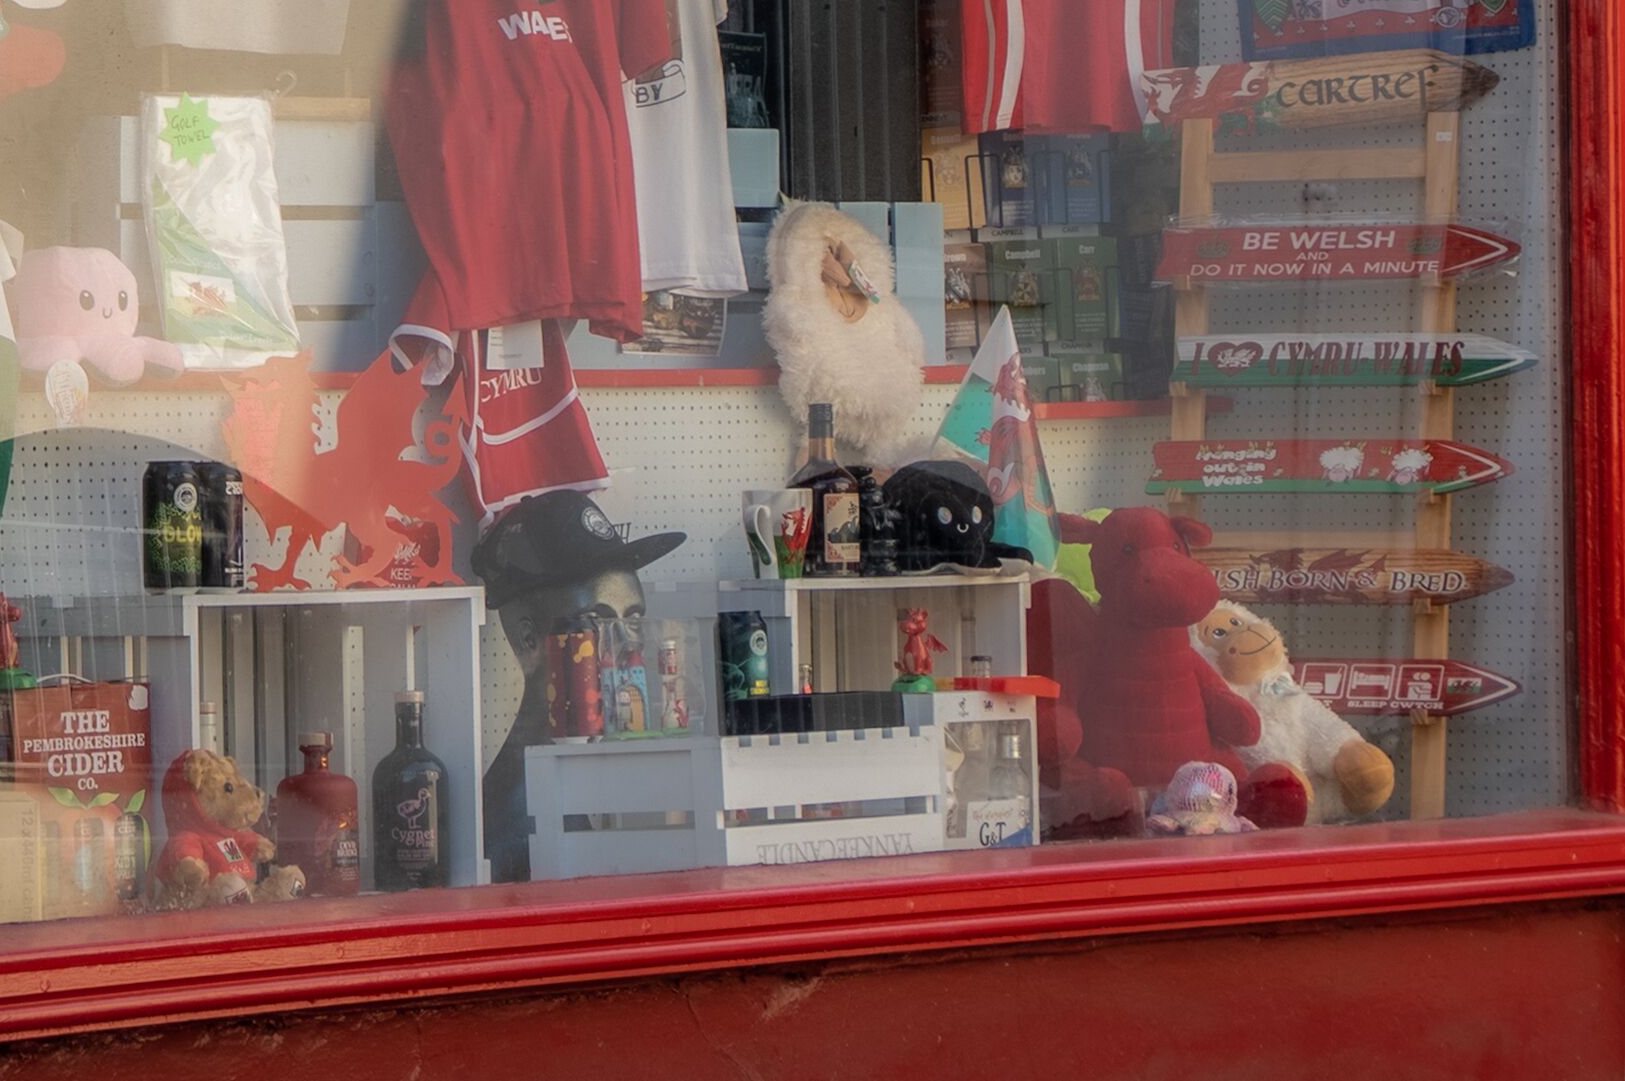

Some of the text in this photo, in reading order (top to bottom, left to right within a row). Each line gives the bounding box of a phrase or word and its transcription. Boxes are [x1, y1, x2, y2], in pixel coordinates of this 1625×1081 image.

[635, 83, 664, 104] BY
[171, 114, 200, 132] GOLF
[173, 128, 211, 148] TOWEL
[1242, 230, 1396, 251] BE WELSH
[1296, 251, 1329, 262] AND
[1189, 260, 1440, 277] DO IT NOW IN A MINUTE
[1191, 341, 1205, 377] I
[480, 366, 543, 403] CYMRU
[1203, 462, 1265, 473] out in
[1202, 474, 1264, 487] Wales
[390, 568, 412, 580] KEE
[1268, 569, 1349, 592] BORN
[1356, 568, 1378, 587] &
[1390, 569, 1464, 593] BRED
[1347, 701, 1444, 710] SLEEP CWTCH
[61, 710, 110, 734] THE
[23, 732, 145, 753] PEMBROKESHIRE
[47, 750, 125, 777] CIDER
[77, 777, 99, 790] CO.
